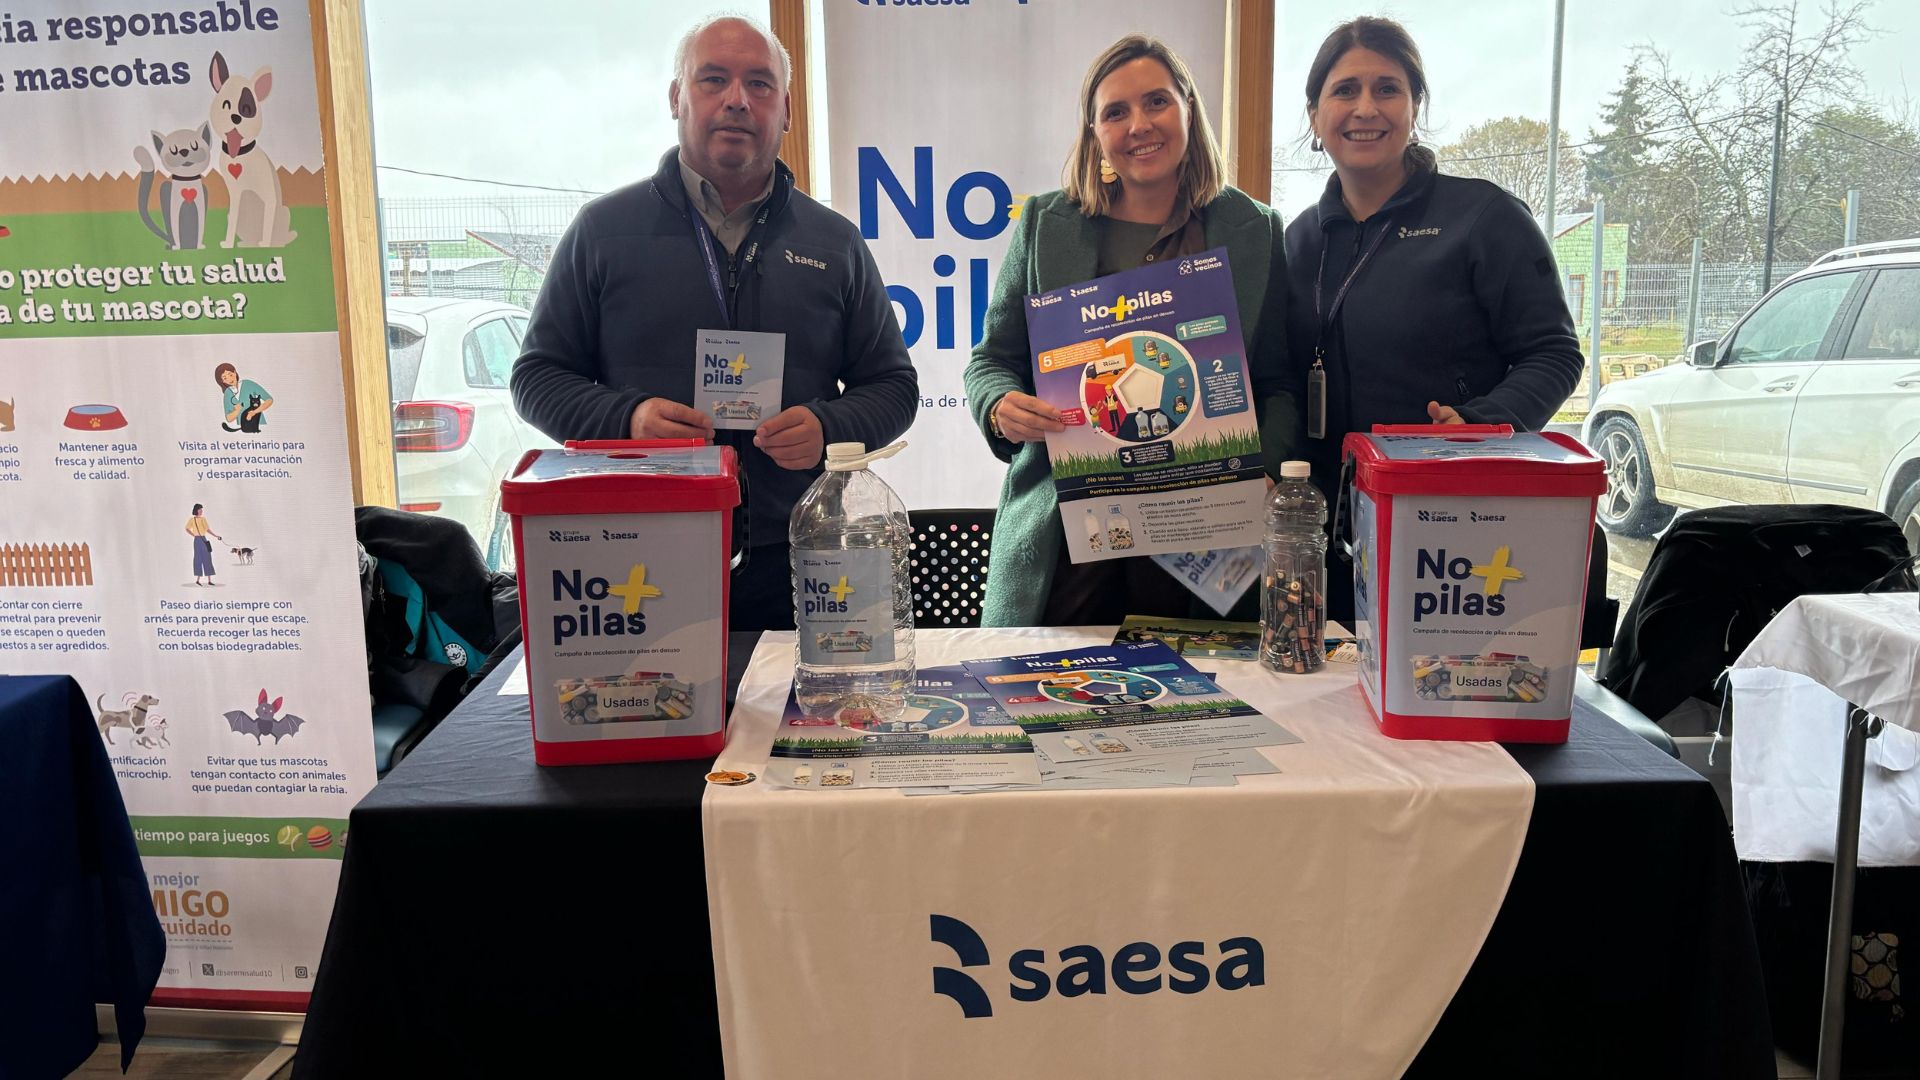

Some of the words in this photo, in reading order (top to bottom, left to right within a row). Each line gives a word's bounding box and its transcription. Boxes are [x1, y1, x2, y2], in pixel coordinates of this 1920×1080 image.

[0, 13, 38, 43] ia
[47, 0, 279, 46] responsable
[14, 58, 191, 91] mascotas
[1406, 227, 1440, 237] saesa
[795, 255, 827, 270] saesa
[1194, 256, 1217, 266] Somos
[1194, 261, 1222, 272] vecinos
[20, 263, 154, 295] proteger
[161, 260, 196, 286] tu
[203, 256, 286, 285] salud
[1076, 285, 1098, 296] saesa
[18, 298, 54, 323] de
[61, 299, 95, 323] tu
[103, 293, 247, 322] mascota?
[1179, 325, 1187, 338] 1
[1043, 355, 1053, 368] 5
[1212, 359, 1224, 373] 2
[703, 370, 743, 388] pilas
[938, 394, 957, 408] de
[59, 442, 109, 452] Mantener
[111, 443, 138, 453] agua
[178, 441, 208, 451] Visita
[210, 440, 220, 451] al
[222, 439, 281, 451] veterinario
[282, 442, 305, 452] para
[55, 456, 87, 466] fresca
[88, 458, 95, 468] y
[97, 455, 145, 466] alimento
[183, 456, 242, 467] programar
[245, 454, 303, 464] vacunación
[1121, 451, 1133, 463] 3
[73, 470, 87, 480] de
[88, 469, 130, 480] calidad.
[197, 471, 204, 481] y
[206, 468, 292, 481] desparasitación.
[610, 532, 639, 540] saesa
[31, 601, 50, 610] con
[52, 600, 83, 610] cierre
[160, 600, 191, 610] Paseo
[194, 600, 223, 610] diario
[226, 600, 270, 612] siempre
[273, 601, 293, 609] con
[805, 596, 849, 616] pilas
[1413, 583, 1506, 622] pilas
[34, 615, 56, 625] para
[58, 613, 102, 625] prevenir
[144, 614, 174, 624] arnés
[176, 615, 199, 625] para
[201, 614, 245, 625] prevenir
[248, 615, 269, 625] que
[271, 614, 309, 625] escape.
[554, 604, 647, 646] pilas
[0, 629, 12, 637] se
[14, 628, 54, 639] escapen
[56, 629, 64, 637] o
[66, 627, 106, 639] queden
[157, 627, 206, 637] Recuerda
[208, 629, 250, 639] recoger
[252, 628, 268, 637] las
[270, 627, 301, 637] heces
[30, 642, 36, 650] a
[38, 642, 54, 650] ser
[55, 640, 110, 652] agredidos.
[158, 642, 179, 651] con
[181, 641, 214, 651] bolsas
[216, 641, 302, 653] biodegradables.
[1456, 675, 1503, 688] Usadas
[603, 696, 650, 709] Usadas
[207, 756, 235, 766] Evitar
[237, 758, 258, 768] que
[260, 757, 277, 766] tus
[279, 757, 328, 767] mascotas
[117, 769, 172, 781] microchip.
[190, 770, 227, 781] tengan
[229, 771, 276, 780] contacto
[279, 771, 300, 780] con
[302, 771, 347, 781] animales
[191, 784, 212, 794] que
[214, 783, 253, 794] puedan
[255, 784, 306, 795] contagiar
[308, 783, 318, 793] la
[320, 784, 348, 794] rabia.
[134, 828, 185, 845] tiempo
[188, 831, 220, 845] para
[222, 828, 270, 845] juegos
[153, 872, 200, 889] mejor
[1009, 936, 1265, 1002] saesa
